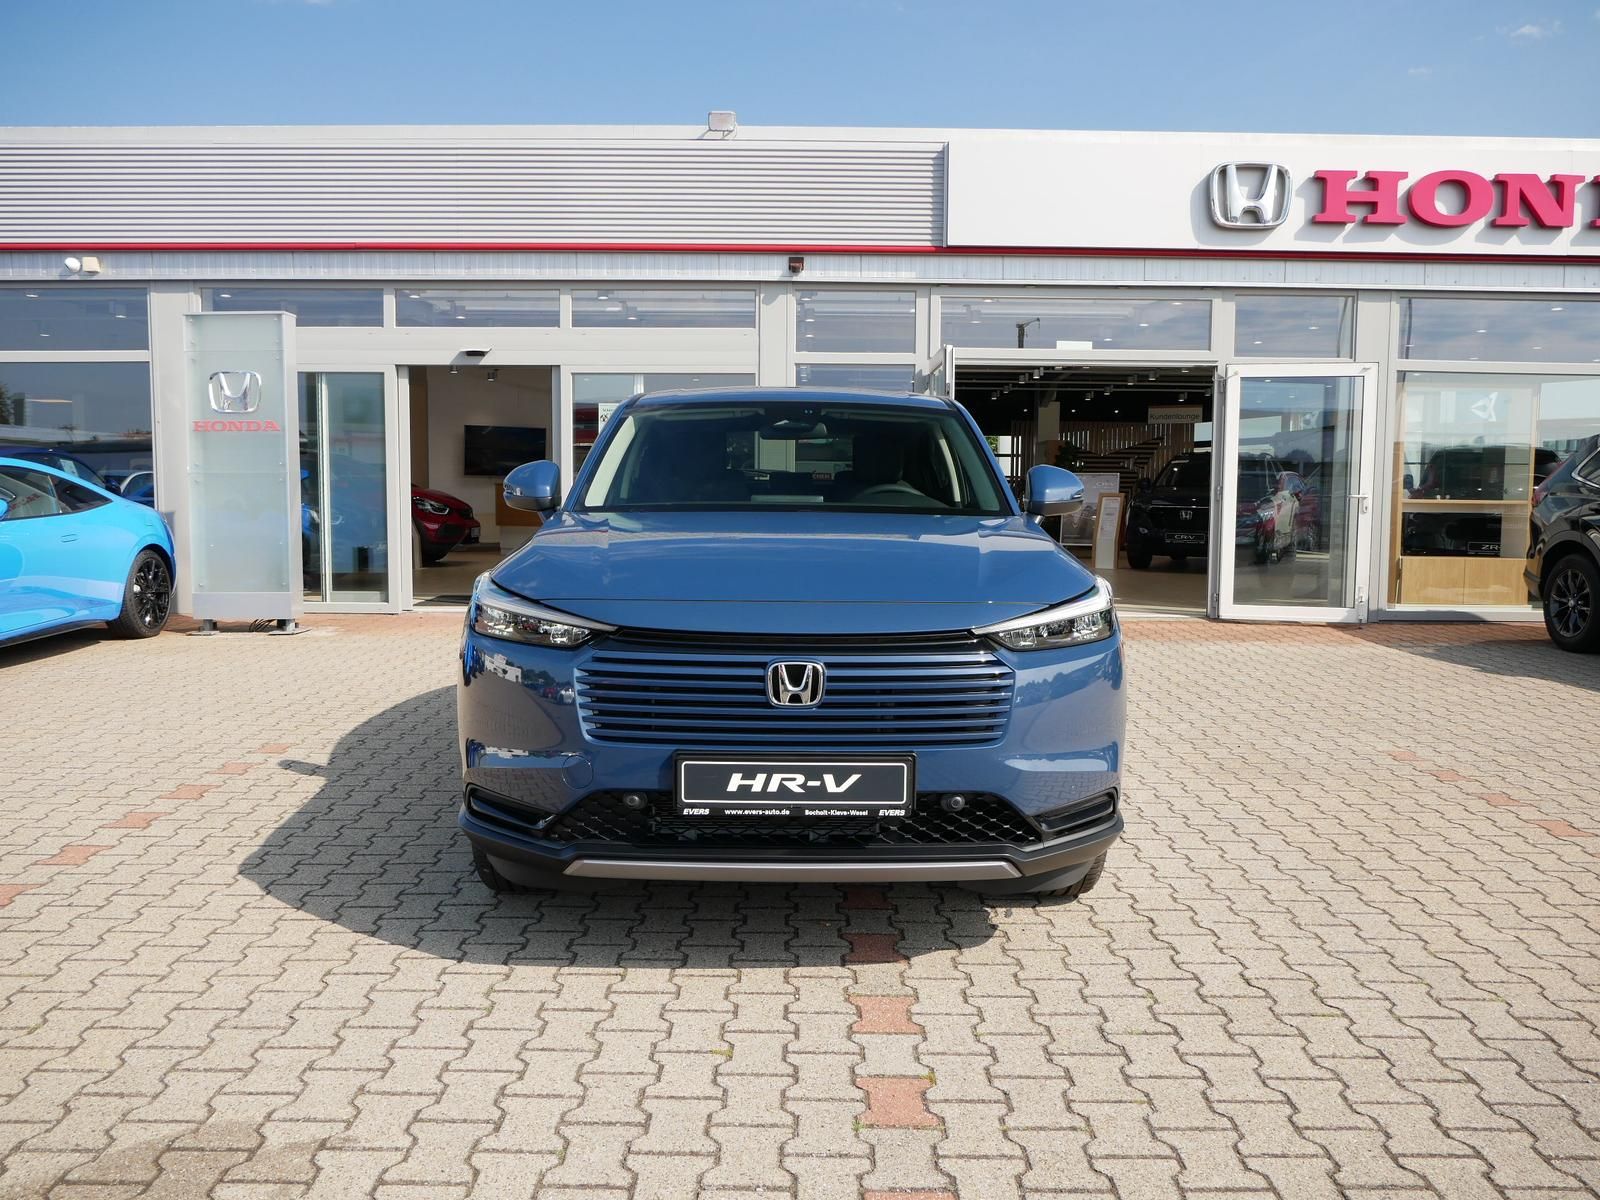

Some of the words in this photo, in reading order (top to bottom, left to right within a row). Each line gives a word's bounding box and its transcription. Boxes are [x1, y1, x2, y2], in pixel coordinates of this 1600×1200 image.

[192, 420, 281, 432] HONDA
[726, 772, 862, 793] HR-V
[682, 808, 710, 816] EVERS
[724, 808, 790, 816] www.evers-auto.de
[878, 809, 906, 817] EVERS
